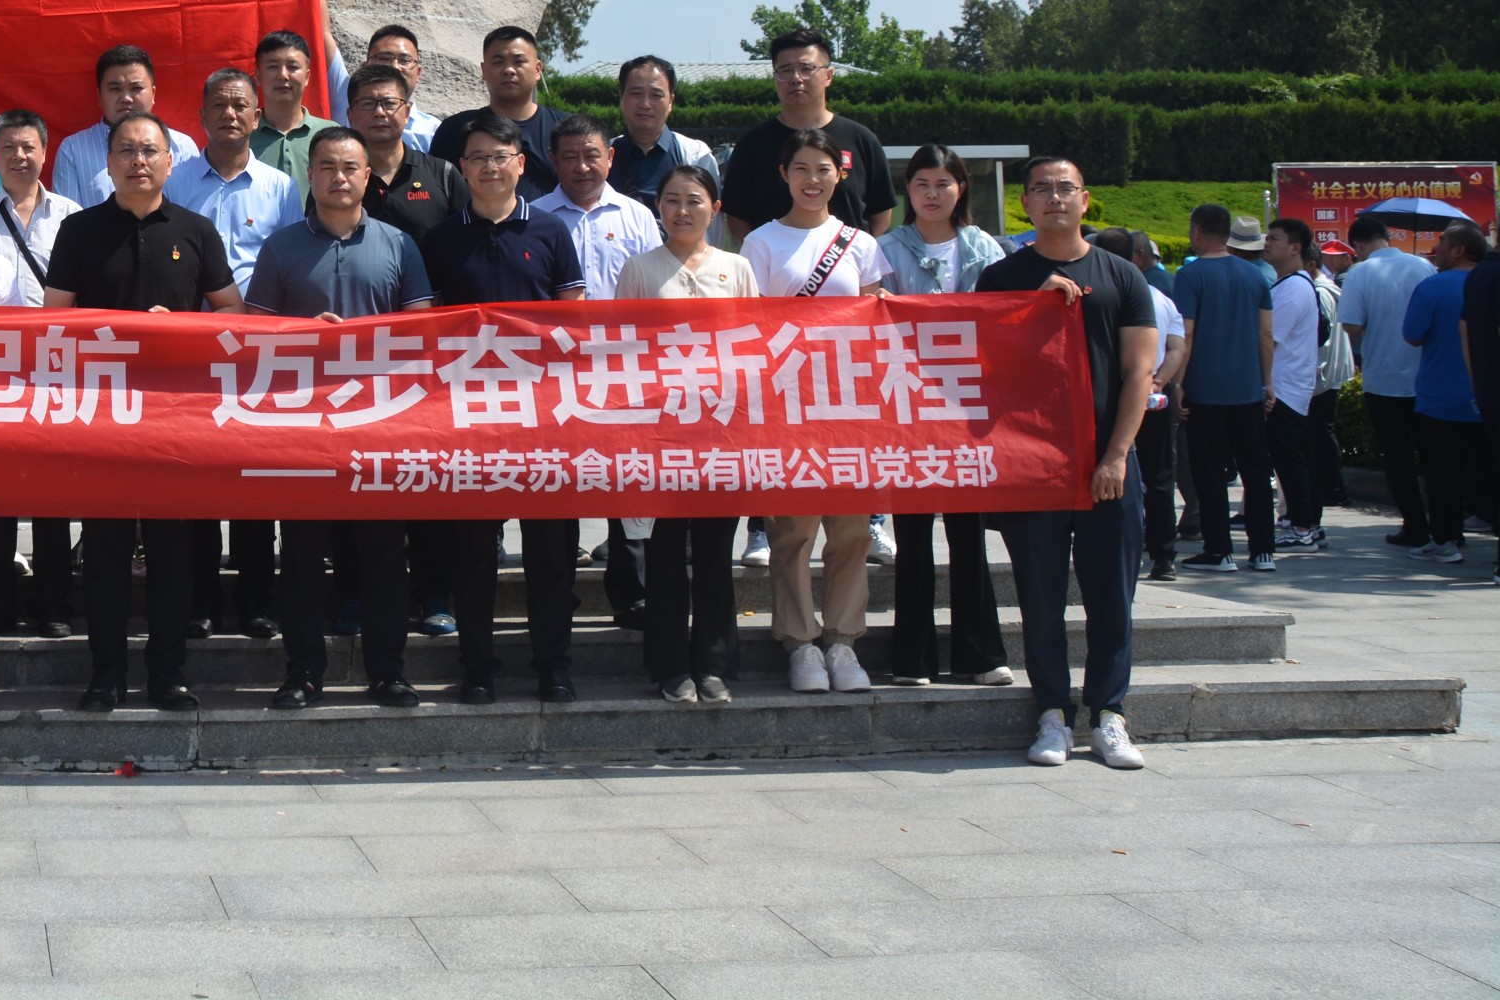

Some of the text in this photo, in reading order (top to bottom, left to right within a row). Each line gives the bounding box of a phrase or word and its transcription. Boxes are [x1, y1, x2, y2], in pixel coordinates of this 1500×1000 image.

[407, 191, 430, 200] CHINA
[1312, 181, 1462, 200] 社会主义核心价值观
[1316, 210, 1336, 220] 国家
[800, 271, 824, 296] YOU
[817, 243, 844, 274] LOVE
[210, 319, 990, 430] 迈步奋进新征程
